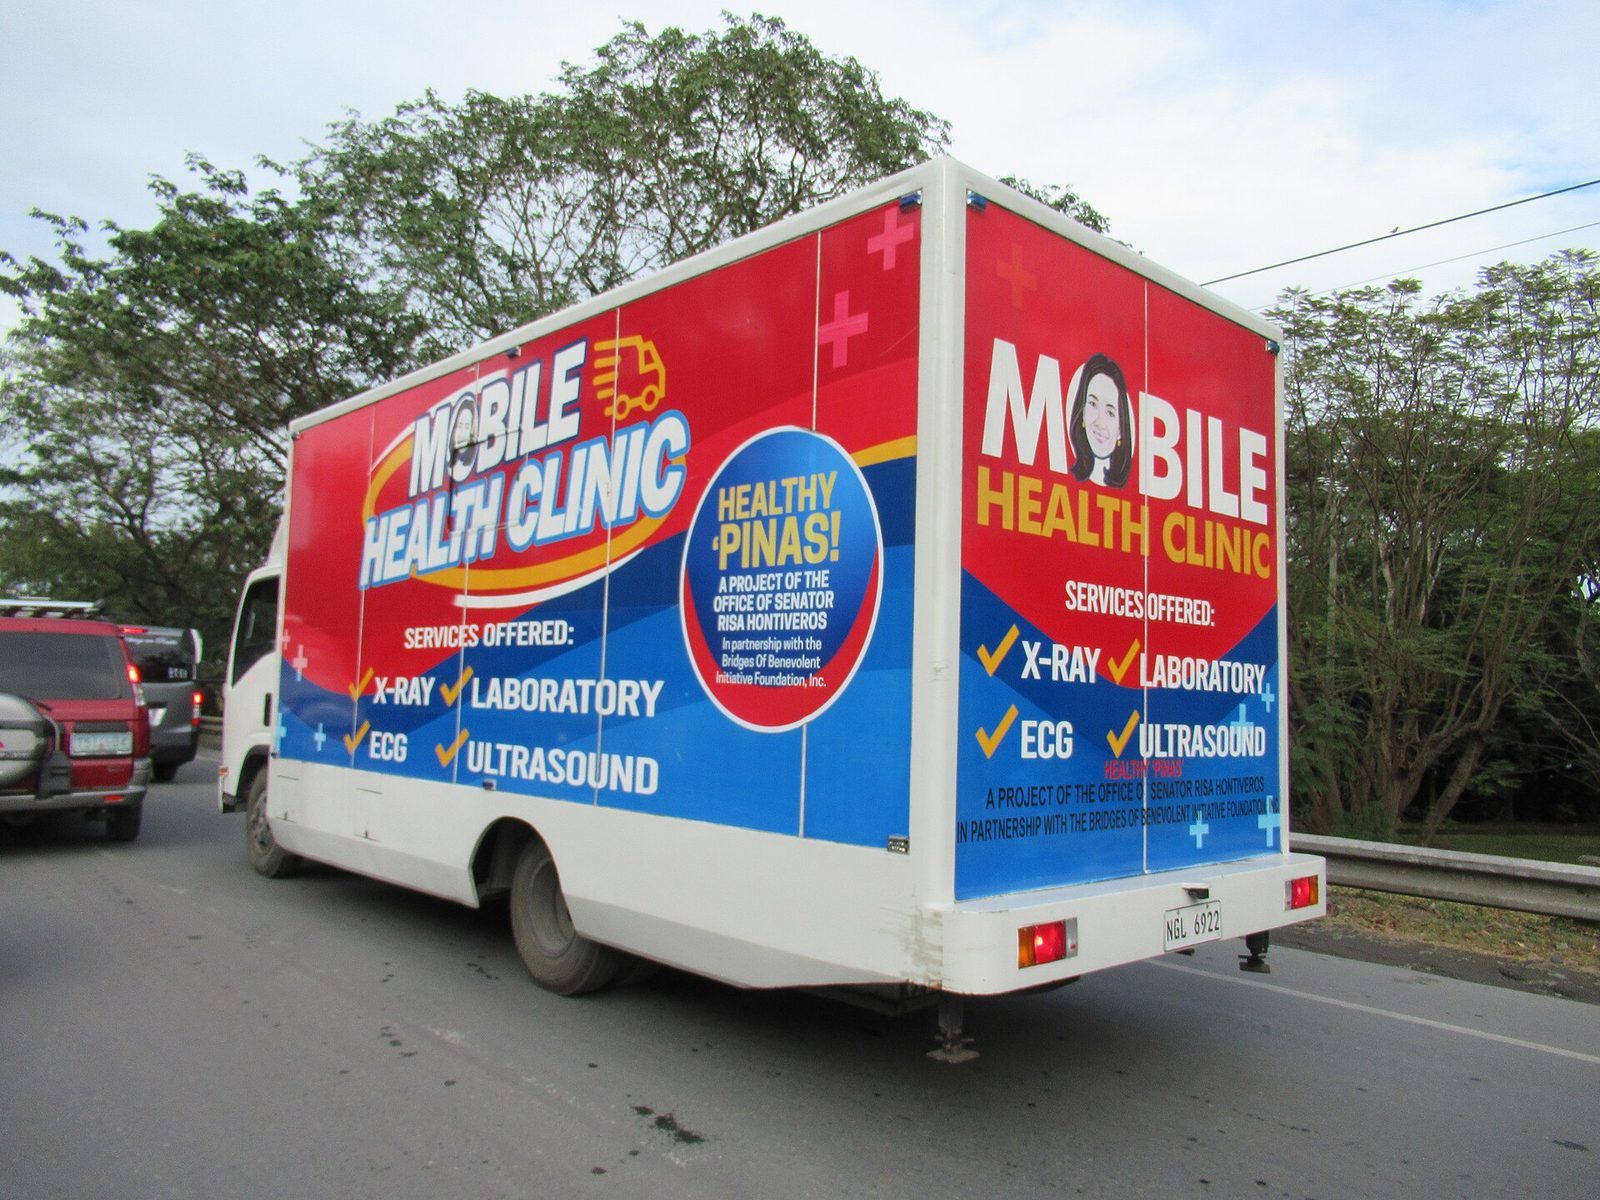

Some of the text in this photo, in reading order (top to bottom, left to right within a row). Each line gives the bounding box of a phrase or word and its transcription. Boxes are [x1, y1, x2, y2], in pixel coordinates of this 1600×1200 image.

[409, 338, 588, 498] MOBILE
[981, 337, 1268, 525] MOBILE
[358, 409, 690, 590] HEALTH CLINIC
[718, 471, 837, 522] HEALTHY
[977, 465, 1271, 579] HEALTH CLINIC
[719, 570, 829, 593] A PROJECT OF THE
[713, 591, 834, 613] OFFICE OF SENATOR
[717, 611, 828, 631] RISA HONTIVEROS
[1065, 580, 1215, 627] SERVICES OFFERED:
[404, 619, 575, 650] SERVICES OFFERED:
[722, 636, 823, 653] In partnership with the
[716, 671, 827, 688] Initiative Foundation, Inc.
[722, 653, 821, 671] Bridges Of Benevolent
[1021, 640, 1266, 694] X-RAY LABORATORY
[372, 676, 664, 717] X-RAY LABORATORY
[1021, 720, 1266, 759] ECG ULTRASOUND
[369, 730, 659, 796] ECG ULTRASOUND
[1104, 760, 1150, 780] HEALTHY
[986, 775, 1265, 809] A PROJECT OF THE OFFICE O SENATOR RISA HONTIVEROS
[957, 820, 968, 843] IN
[971, 816, 1042, 843] PARTNERSHIP
[1043, 813, 1067, 835] WITH
[1070, 812, 1087, 832] THE
[1089, 808, 1127, 831] BRIDGES
[1128, 809, 1139, 828] OF
[1141, 804, 1191, 826] BENEVOLENT
[1166, 910, 1220, 942] NGL 6922
